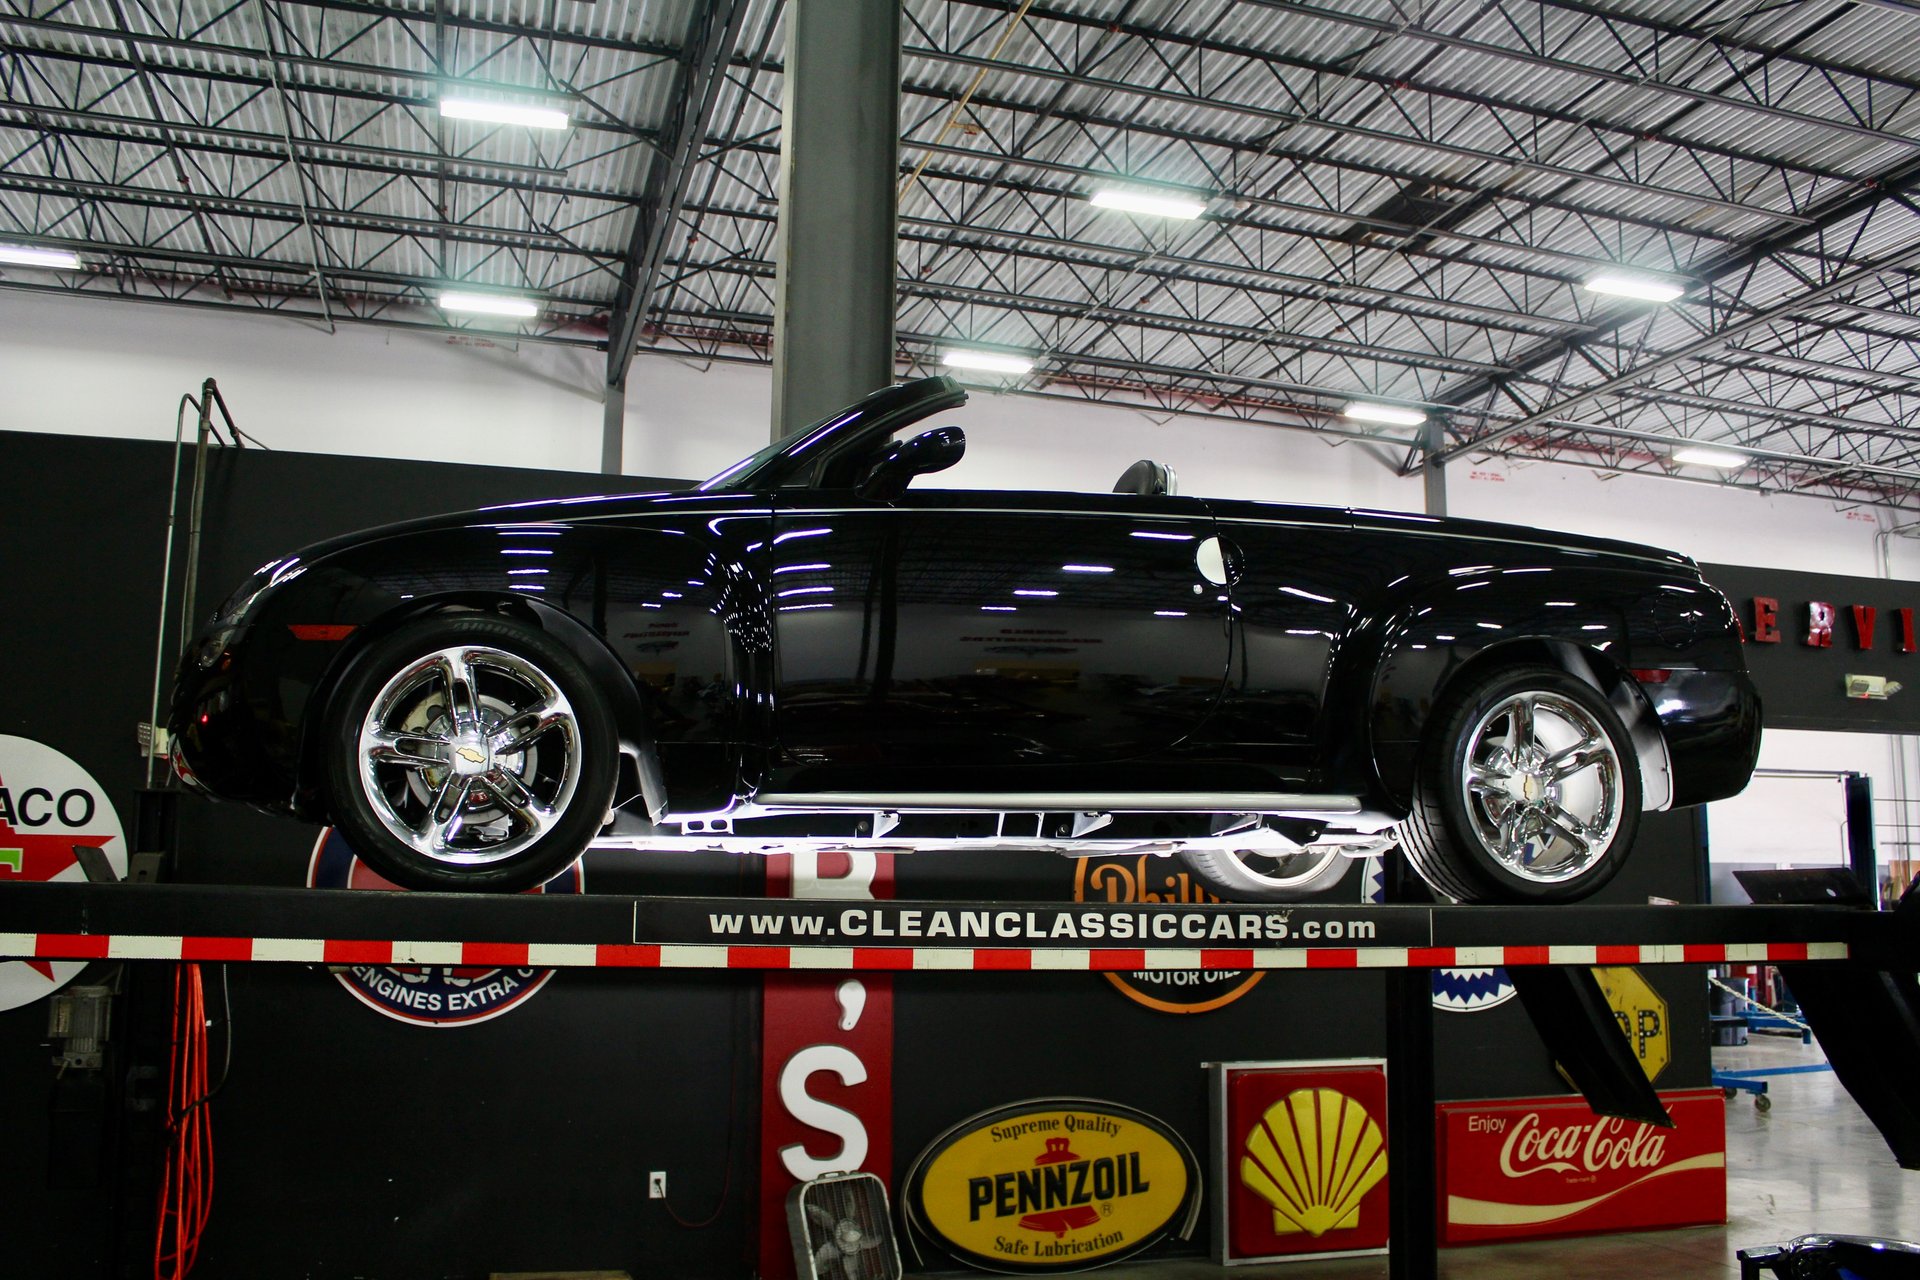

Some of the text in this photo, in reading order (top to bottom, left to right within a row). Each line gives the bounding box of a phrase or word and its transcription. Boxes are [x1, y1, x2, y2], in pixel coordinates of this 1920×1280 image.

[709, 909, 1376, 940] www.CLEANCLASSICCARS.com
[351, 966, 519, 1011] ENGINES EXTRA
[991, 1114, 1121, 1142] Supreme Quality
[1468, 1115, 1507, 1133] Enjoy
[1500, 1112, 1667, 1178] Coca-Cola
[968, 1151, 1150, 1222] PENNZOIL
[994, 1230, 1124, 1257] Safe Lubrication
